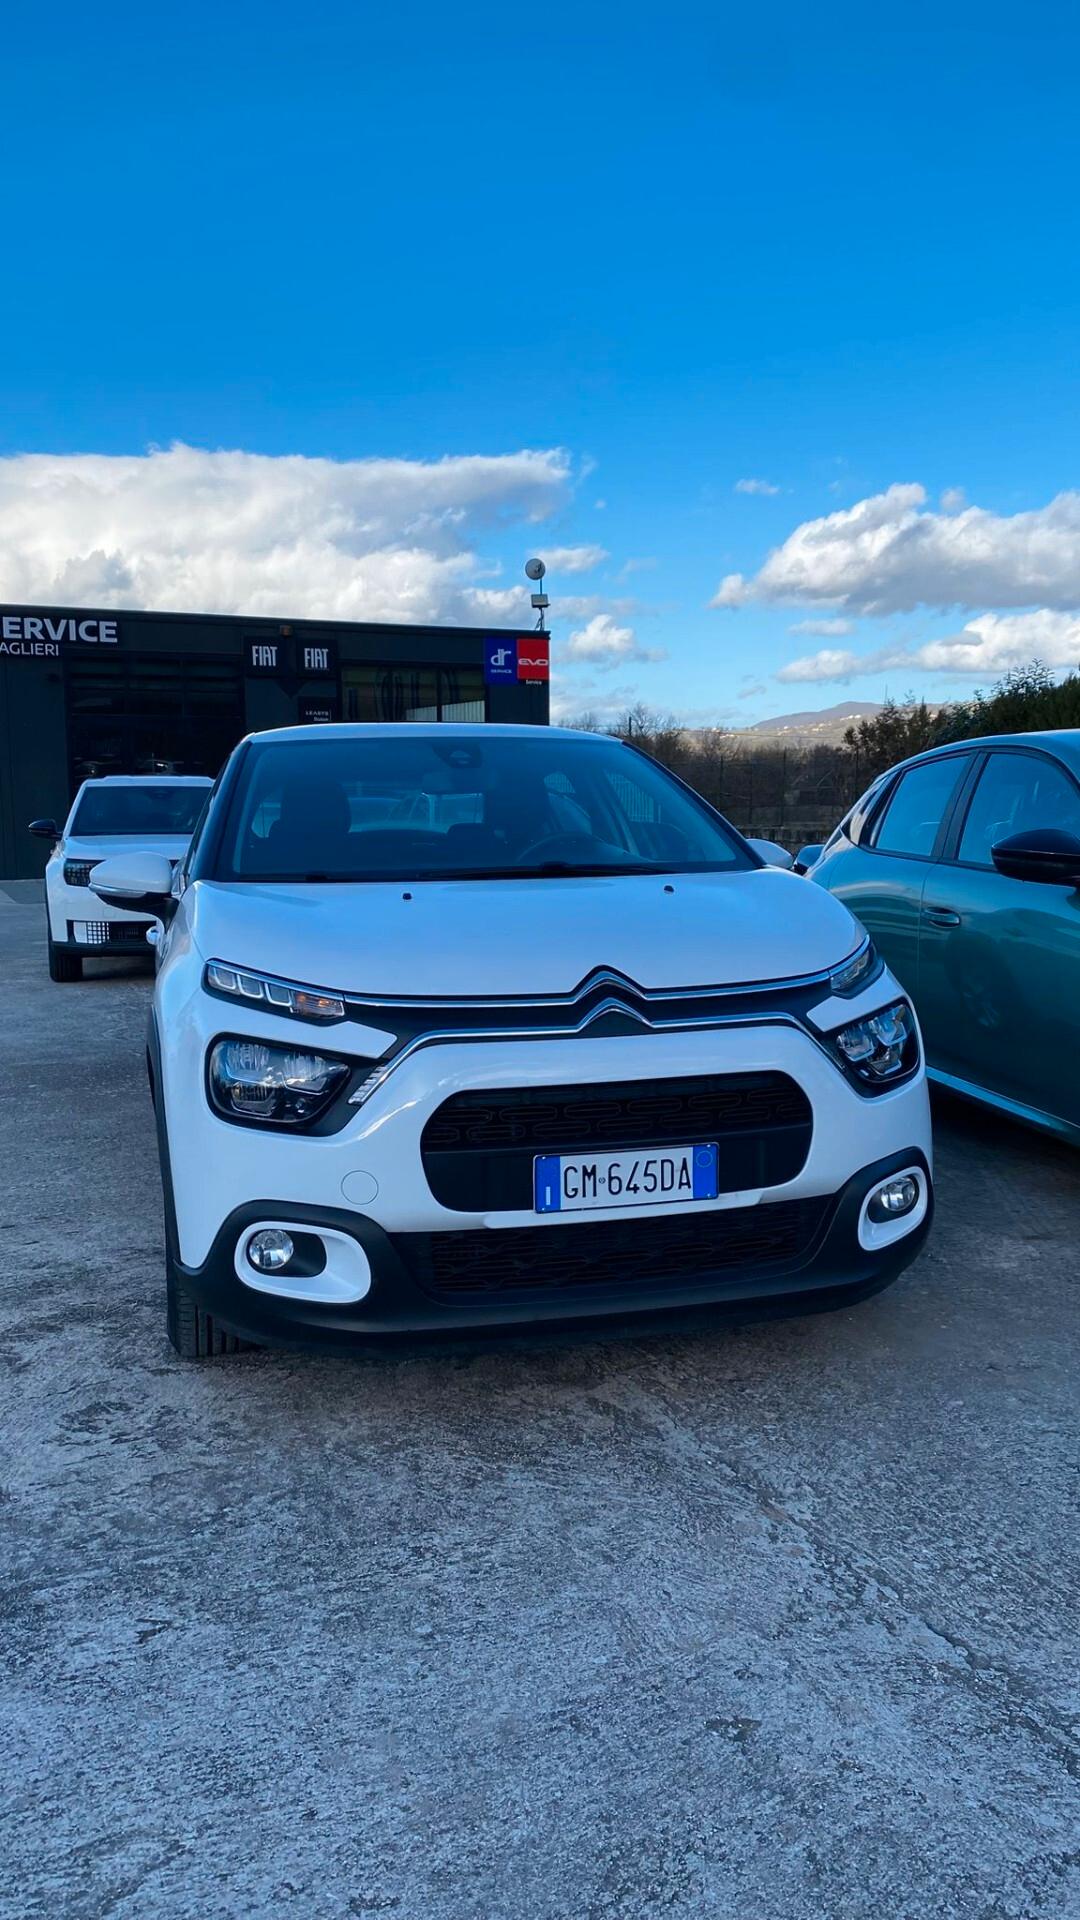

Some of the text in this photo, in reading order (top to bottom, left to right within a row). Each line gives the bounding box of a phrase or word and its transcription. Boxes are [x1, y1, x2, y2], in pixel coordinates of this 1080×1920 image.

[2, 616, 118, 643] ERVICE
[0, 641, 59, 657] AGLIERI
[252, 645, 278, 667] FIAT
[304, 647, 329, 669] FIAT
